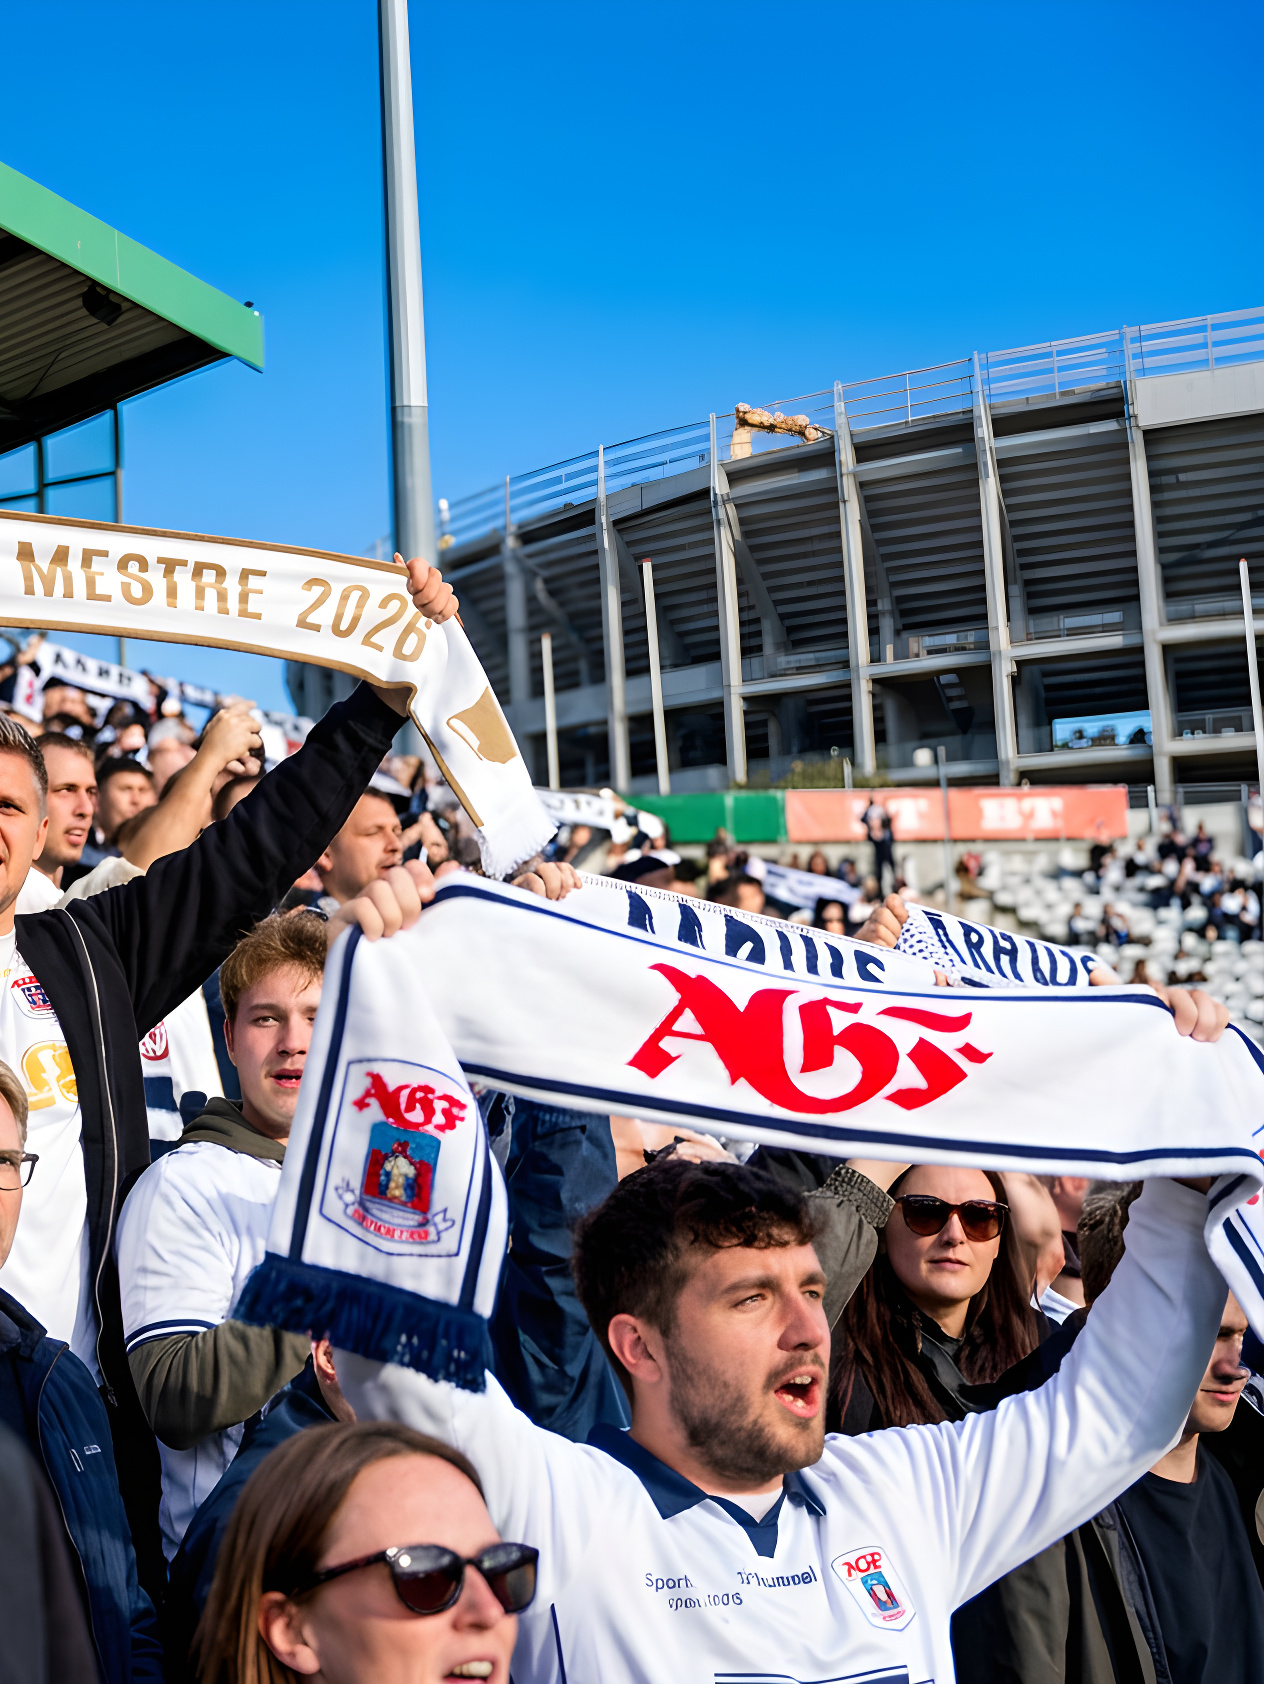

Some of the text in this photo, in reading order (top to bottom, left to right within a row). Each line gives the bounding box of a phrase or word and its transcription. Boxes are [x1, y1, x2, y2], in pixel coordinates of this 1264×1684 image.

[16, 541, 268, 620] MESTRE
[296, 577, 433, 662] 2026
[626, 963, 993, 1114] AGF
